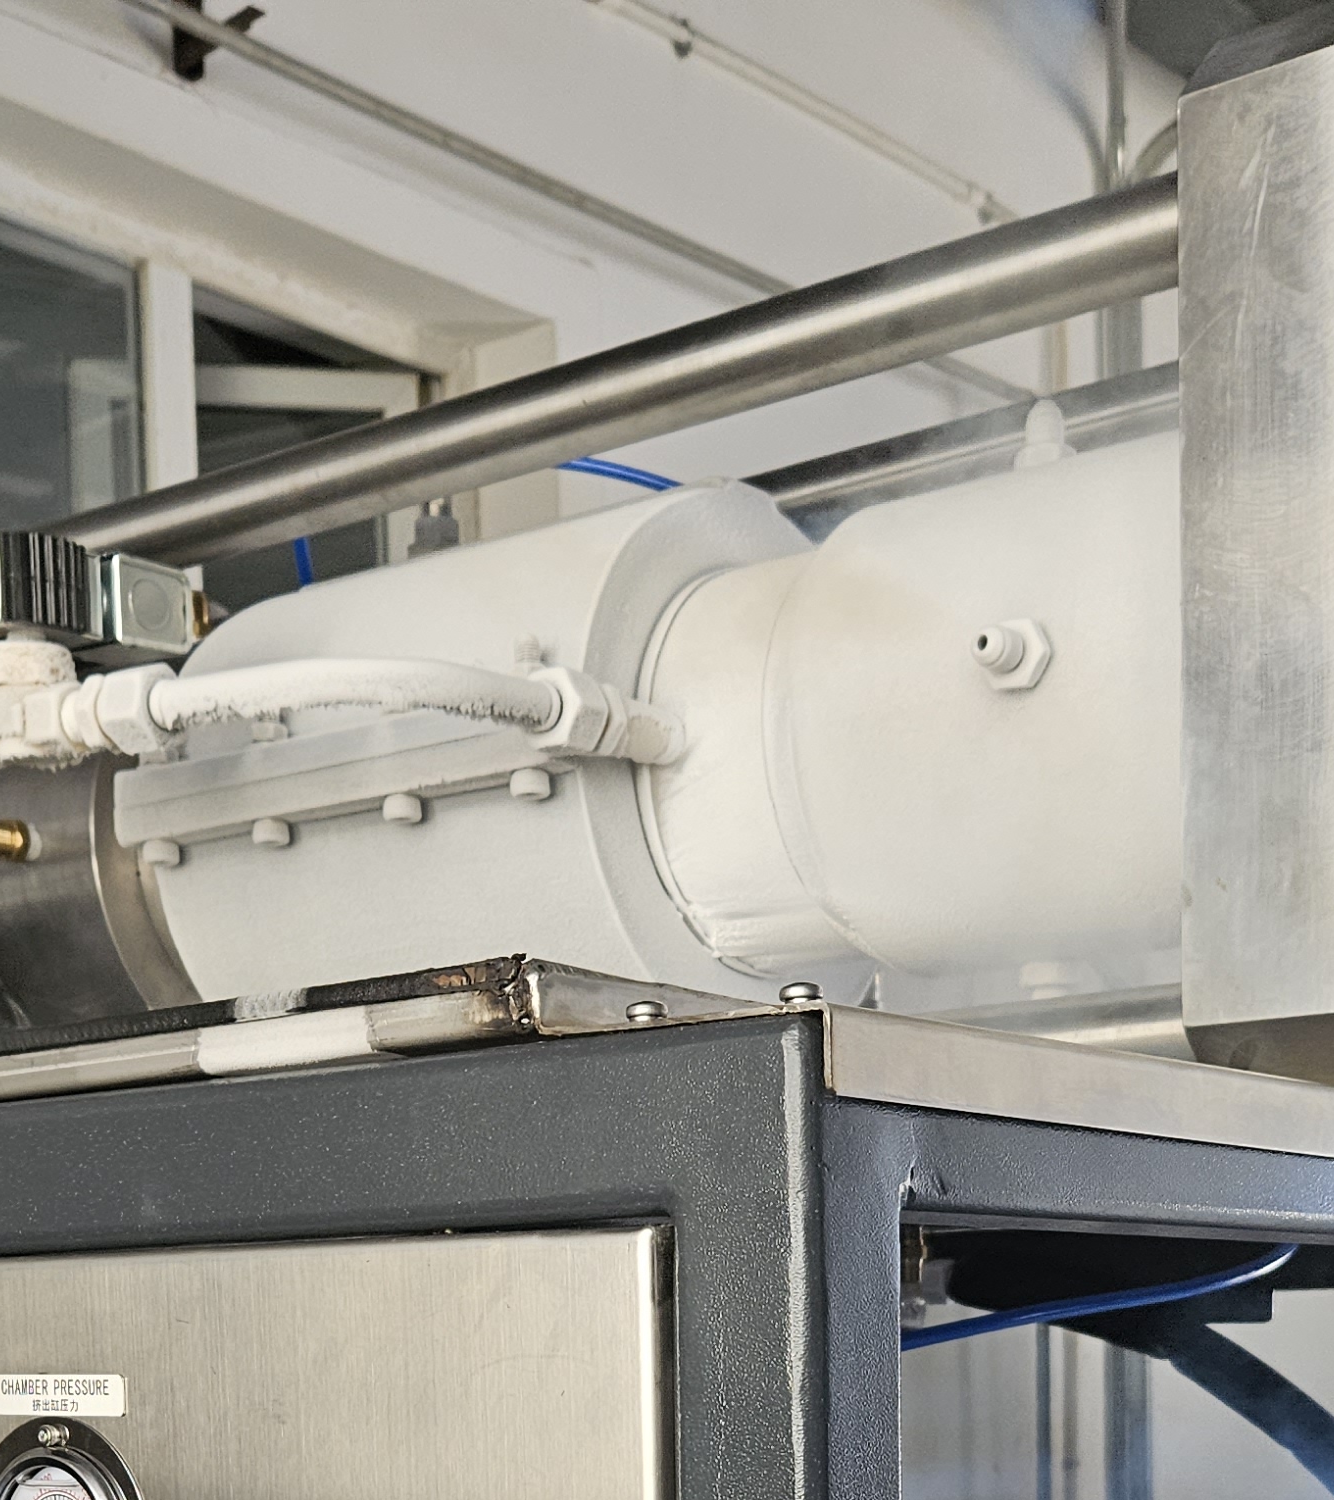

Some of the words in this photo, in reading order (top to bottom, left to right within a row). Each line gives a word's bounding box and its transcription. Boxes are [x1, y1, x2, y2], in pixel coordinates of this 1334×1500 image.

[1, 1379, 49, 1395] CHAMBER
[53, 1379, 109, 1396] PRESSURE
[32, 1399, 79, 1412] 挤出缸压力
